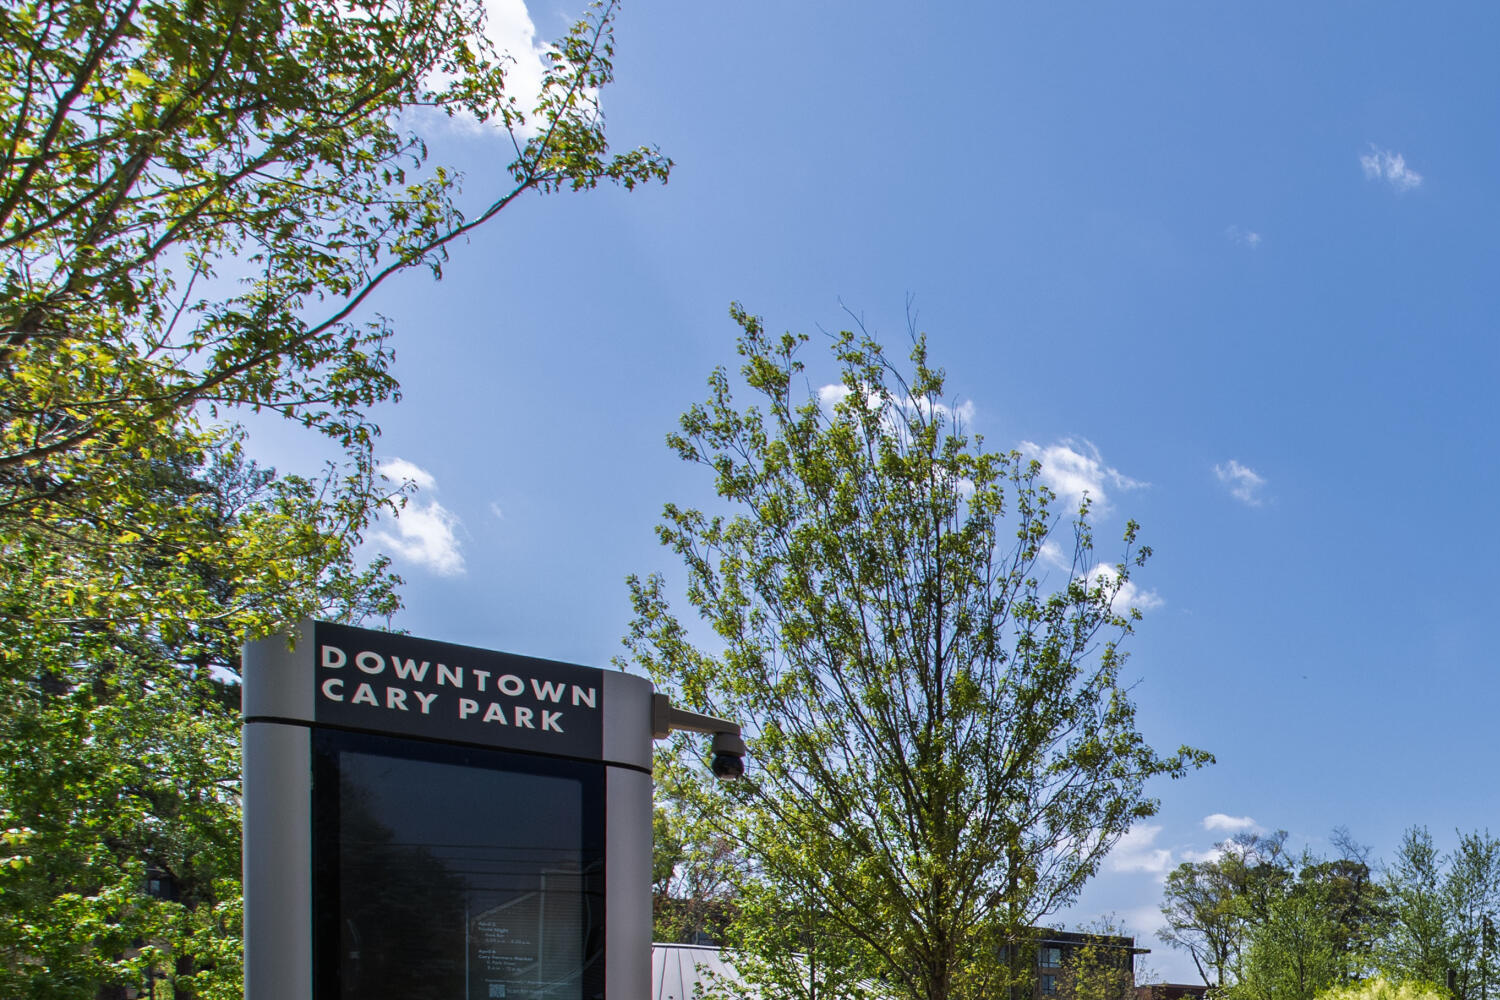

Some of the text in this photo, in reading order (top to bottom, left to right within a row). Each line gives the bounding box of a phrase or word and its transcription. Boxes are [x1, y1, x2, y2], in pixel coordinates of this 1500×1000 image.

[321, 645, 597, 708] DOWNTOWN
[321, 678, 564, 733] CARY PARK
